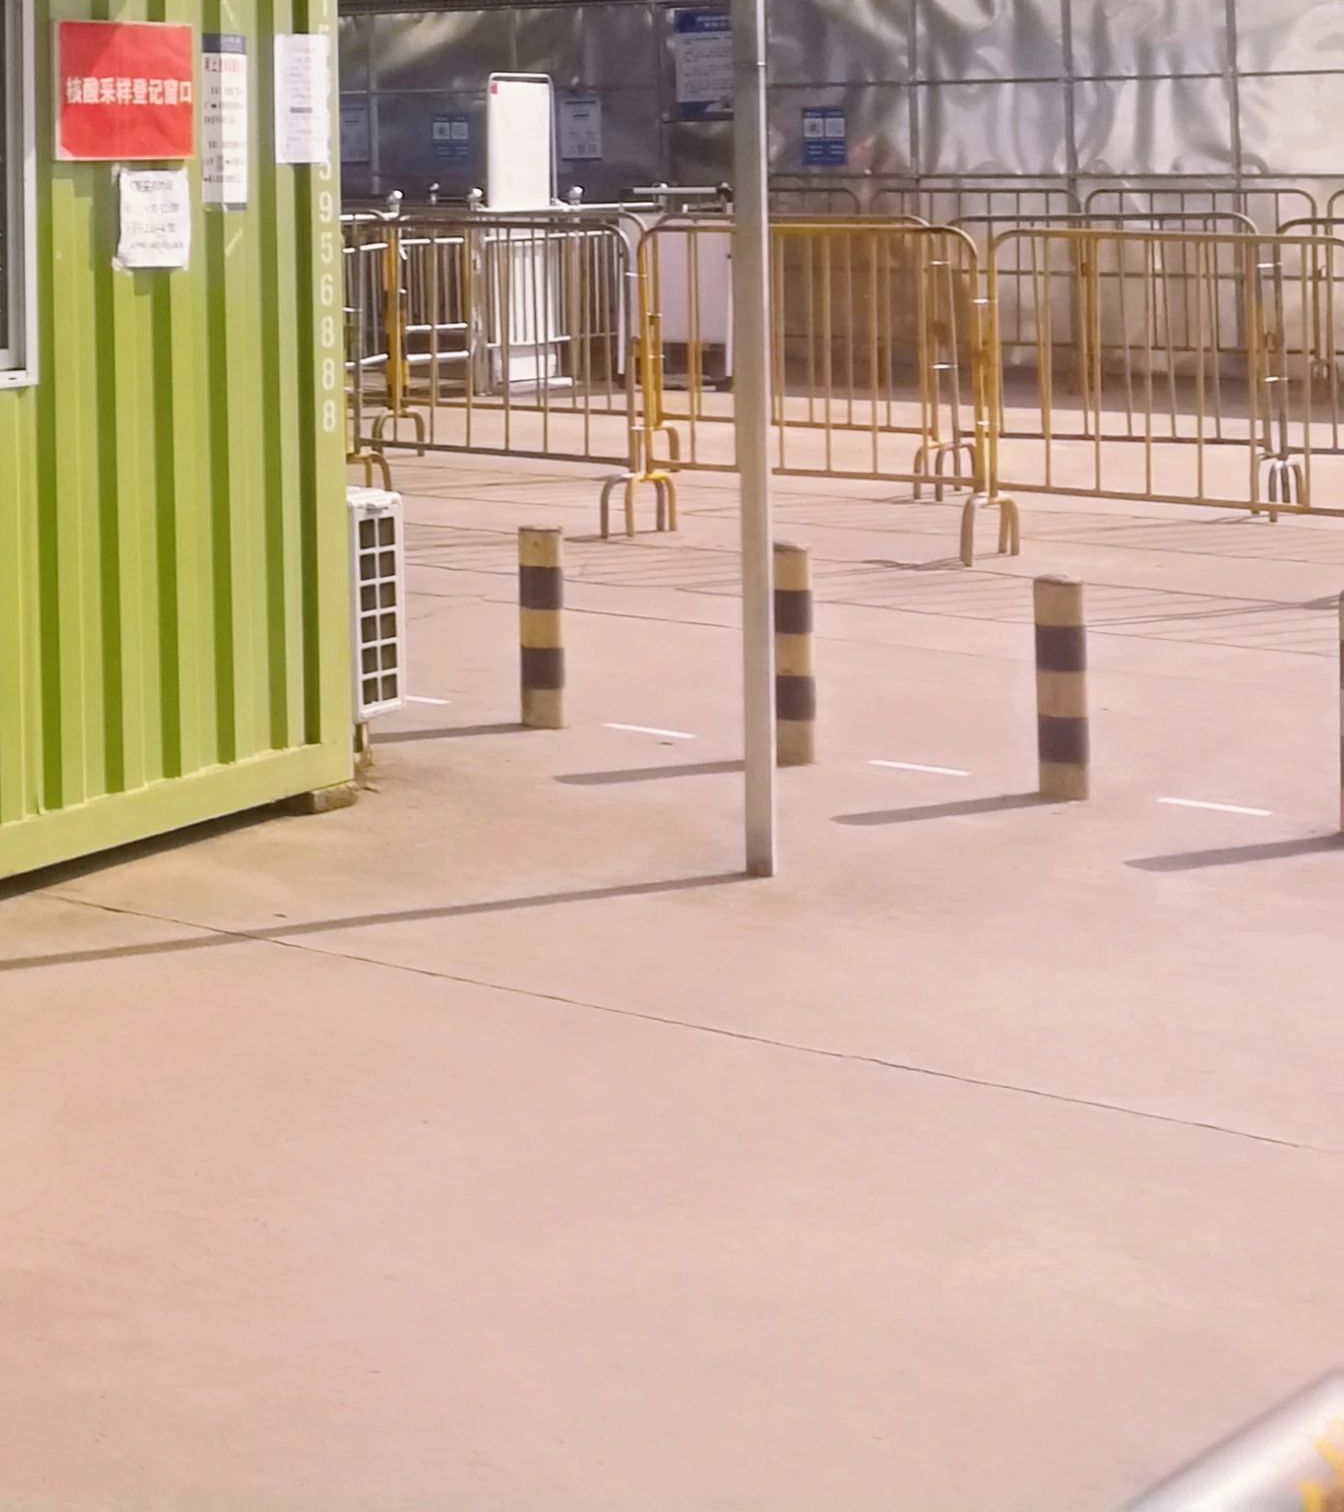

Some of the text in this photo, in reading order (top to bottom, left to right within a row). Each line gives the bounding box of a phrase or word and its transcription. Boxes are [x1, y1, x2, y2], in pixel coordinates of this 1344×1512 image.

[66, 76, 192, 105] 核酸采样登记窗口
